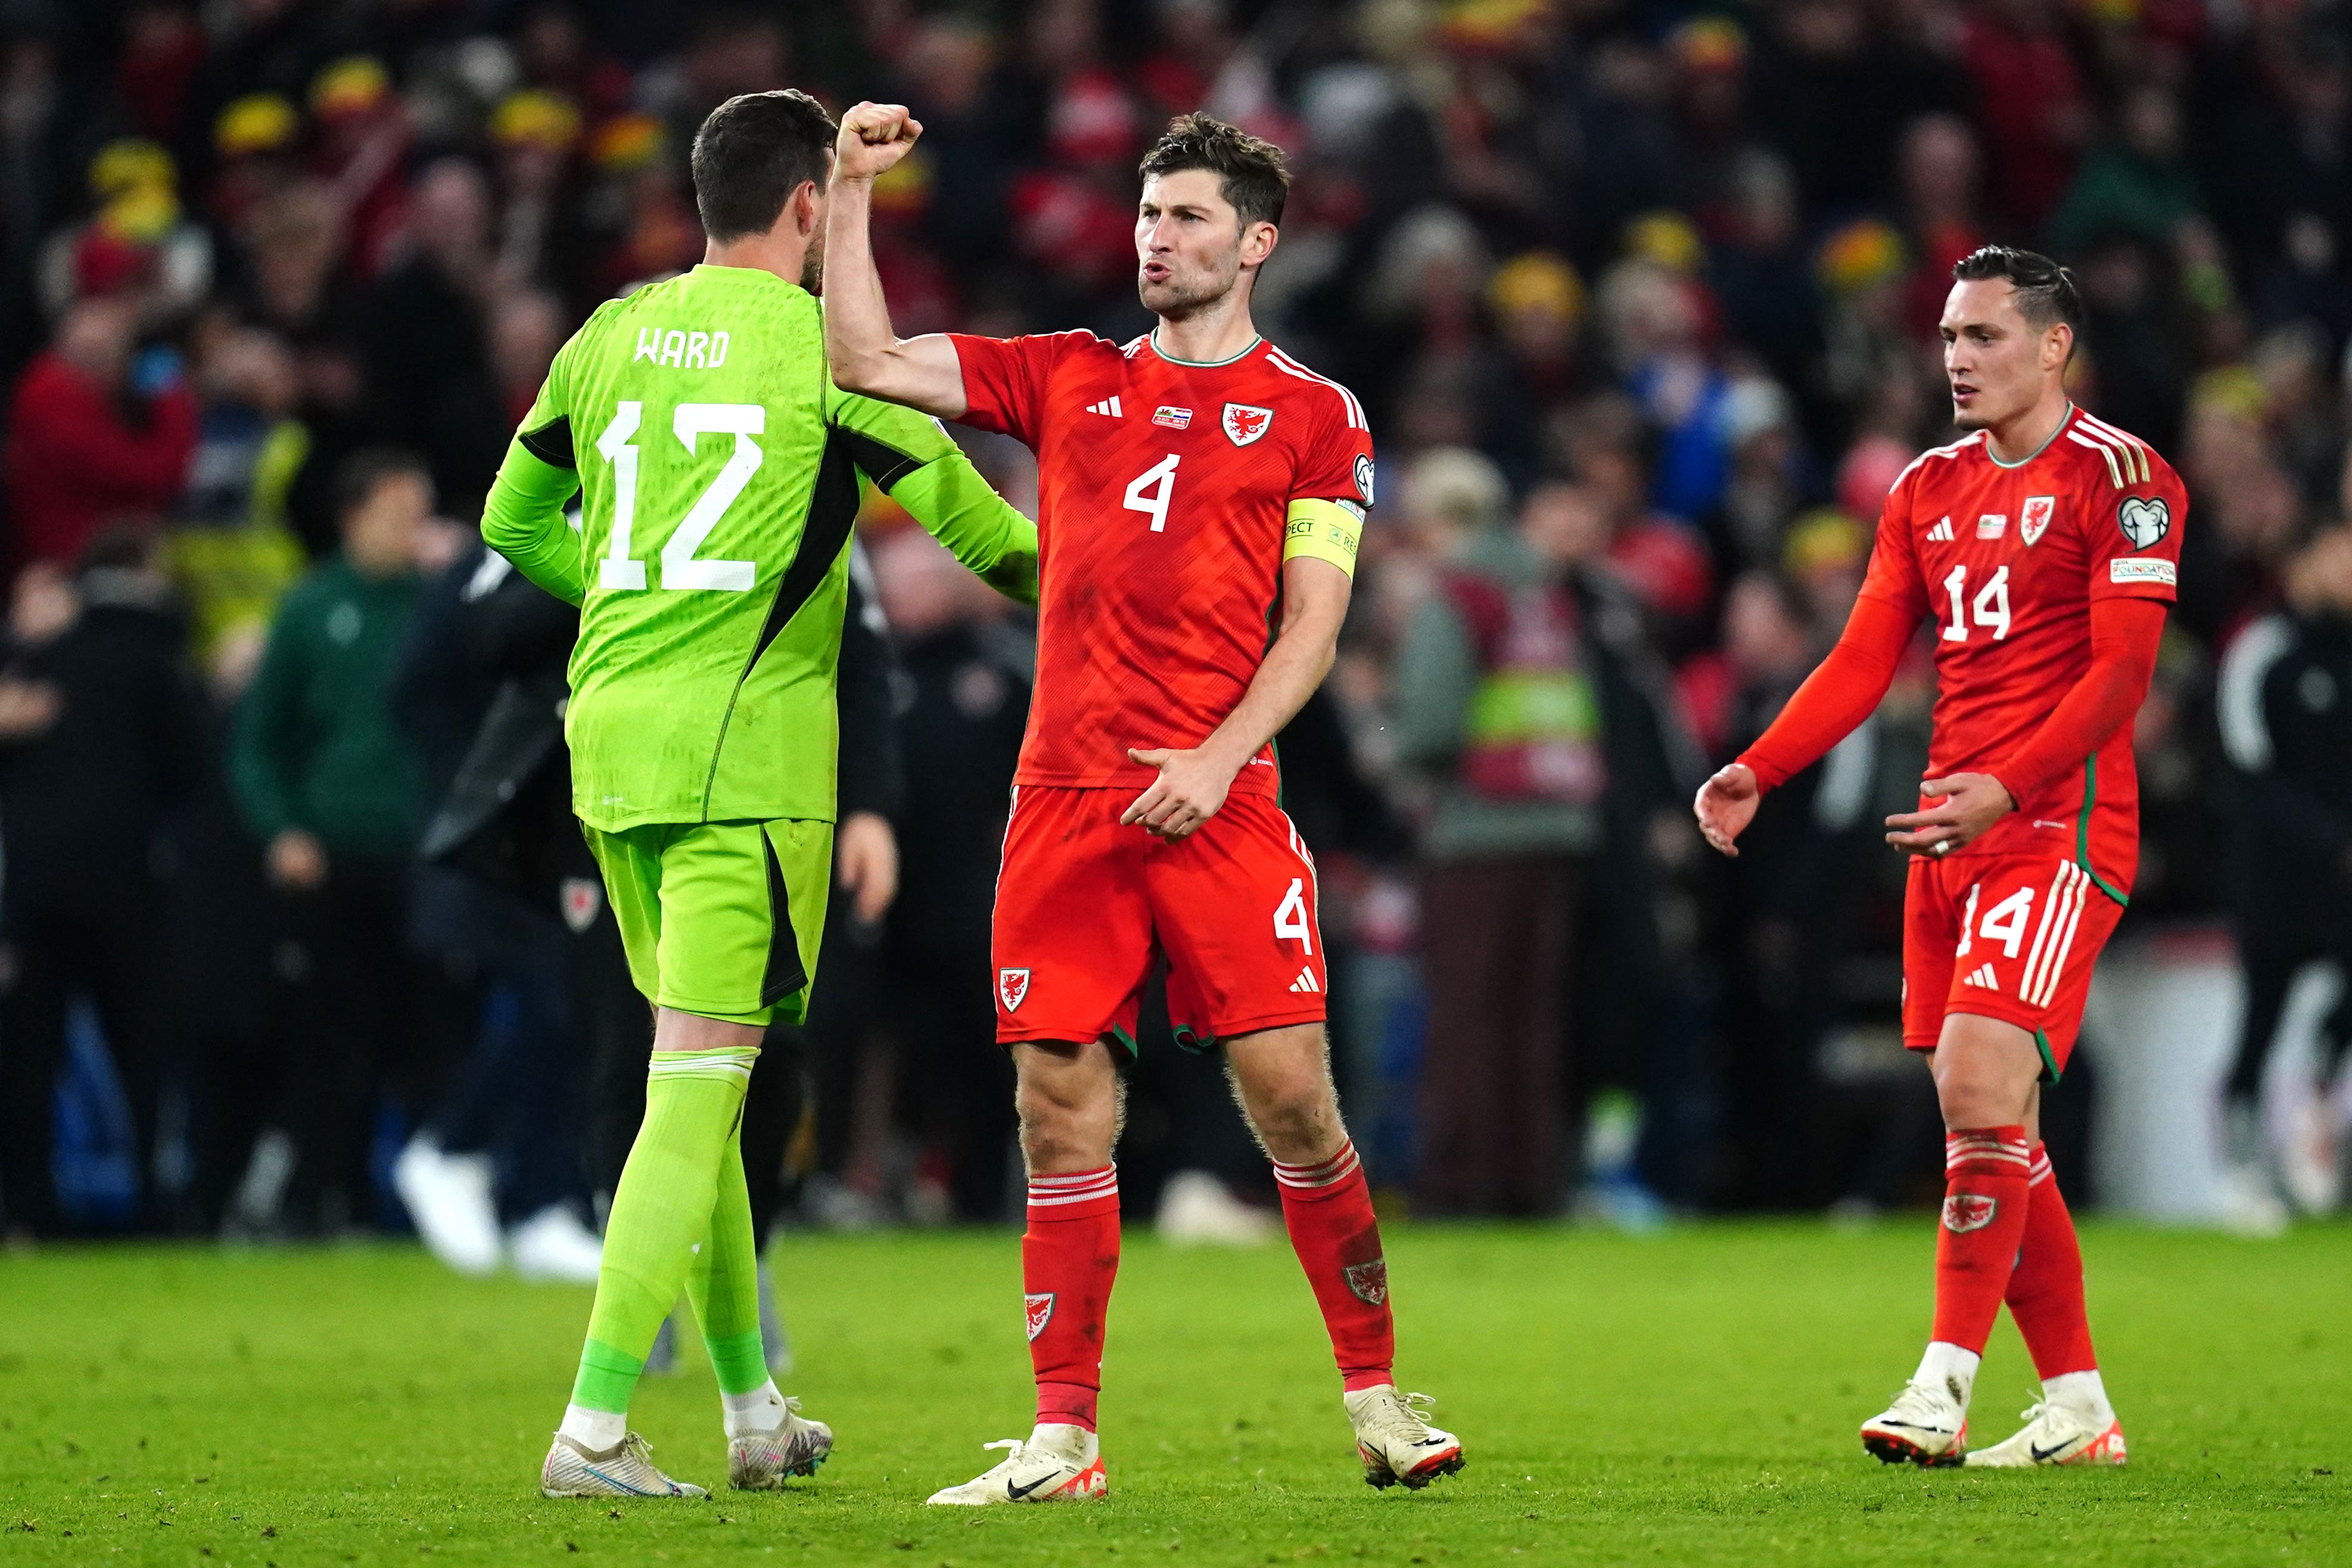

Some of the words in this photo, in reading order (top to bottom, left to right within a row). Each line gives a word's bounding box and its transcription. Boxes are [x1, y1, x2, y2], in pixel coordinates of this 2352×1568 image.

[634, 326, 730, 369] WARD
[596, 400, 766, 592] 12
[1123, 453, 1181, 533] 4
[1943, 565, 2011, 642] 14
[2113, 565, 2174, 576] FOUNDATION
[1273, 878, 1312, 956] 4
[1956, 883, 2034, 959] 14
